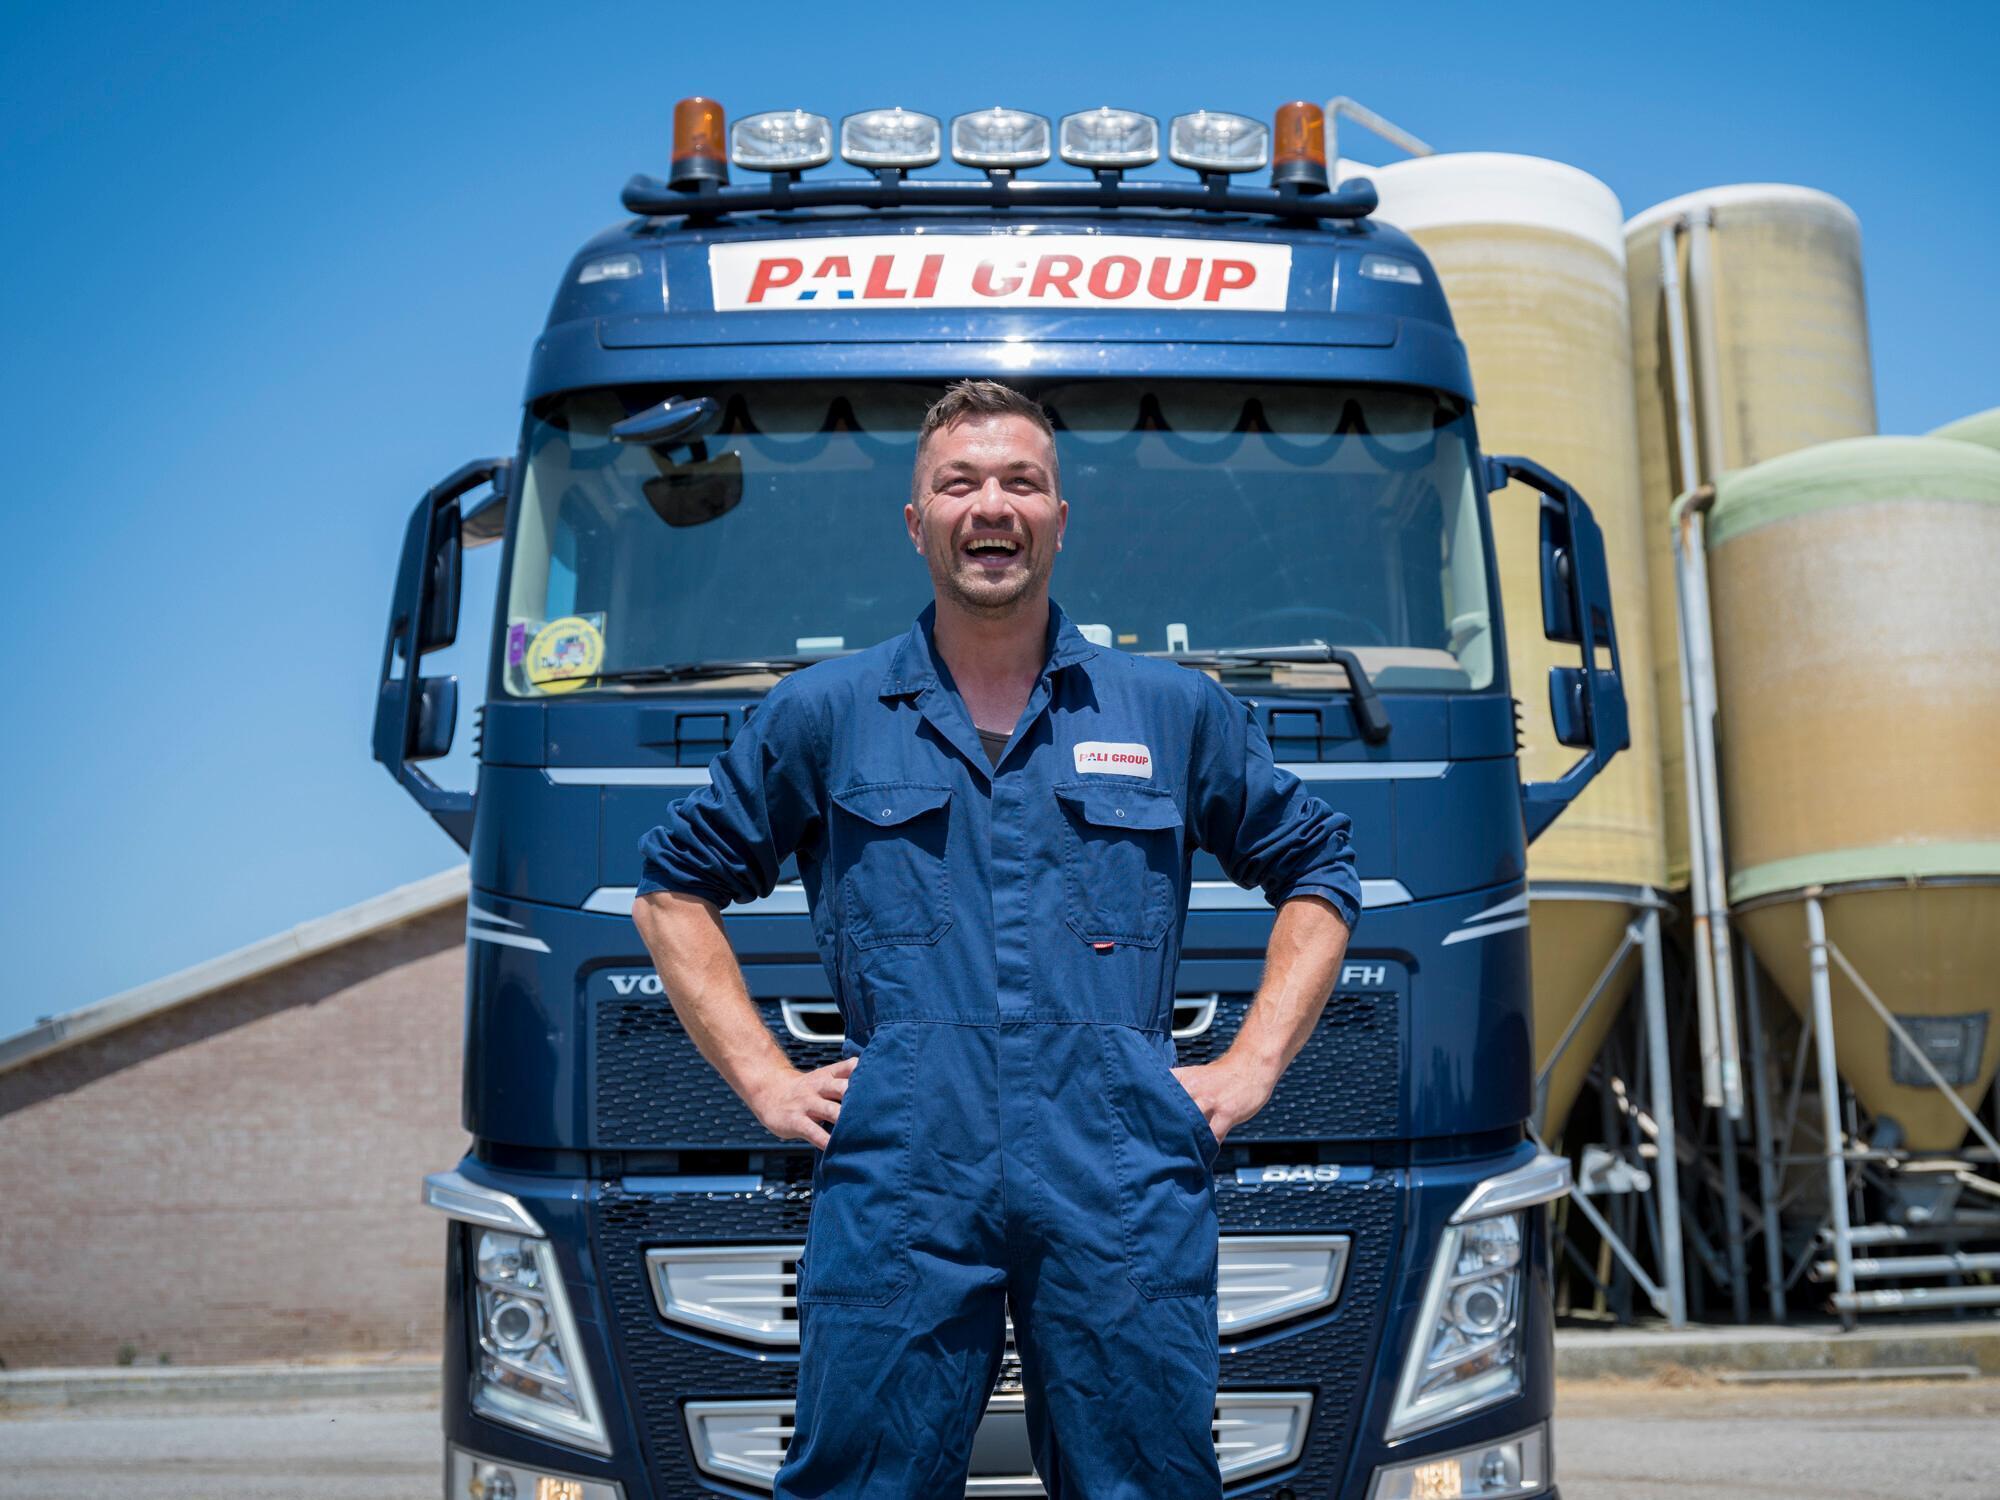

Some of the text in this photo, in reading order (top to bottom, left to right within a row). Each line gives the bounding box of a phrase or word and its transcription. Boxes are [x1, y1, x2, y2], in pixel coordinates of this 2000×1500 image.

[746, 253, 1258, 304] PALI GROUP
[1079, 752, 1149, 766] PALI GROUP
[607, 974, 666, 995] VO
[1341, 966, 1386, 986] FH
[1262, 1164, 1341, 1183] BAS
